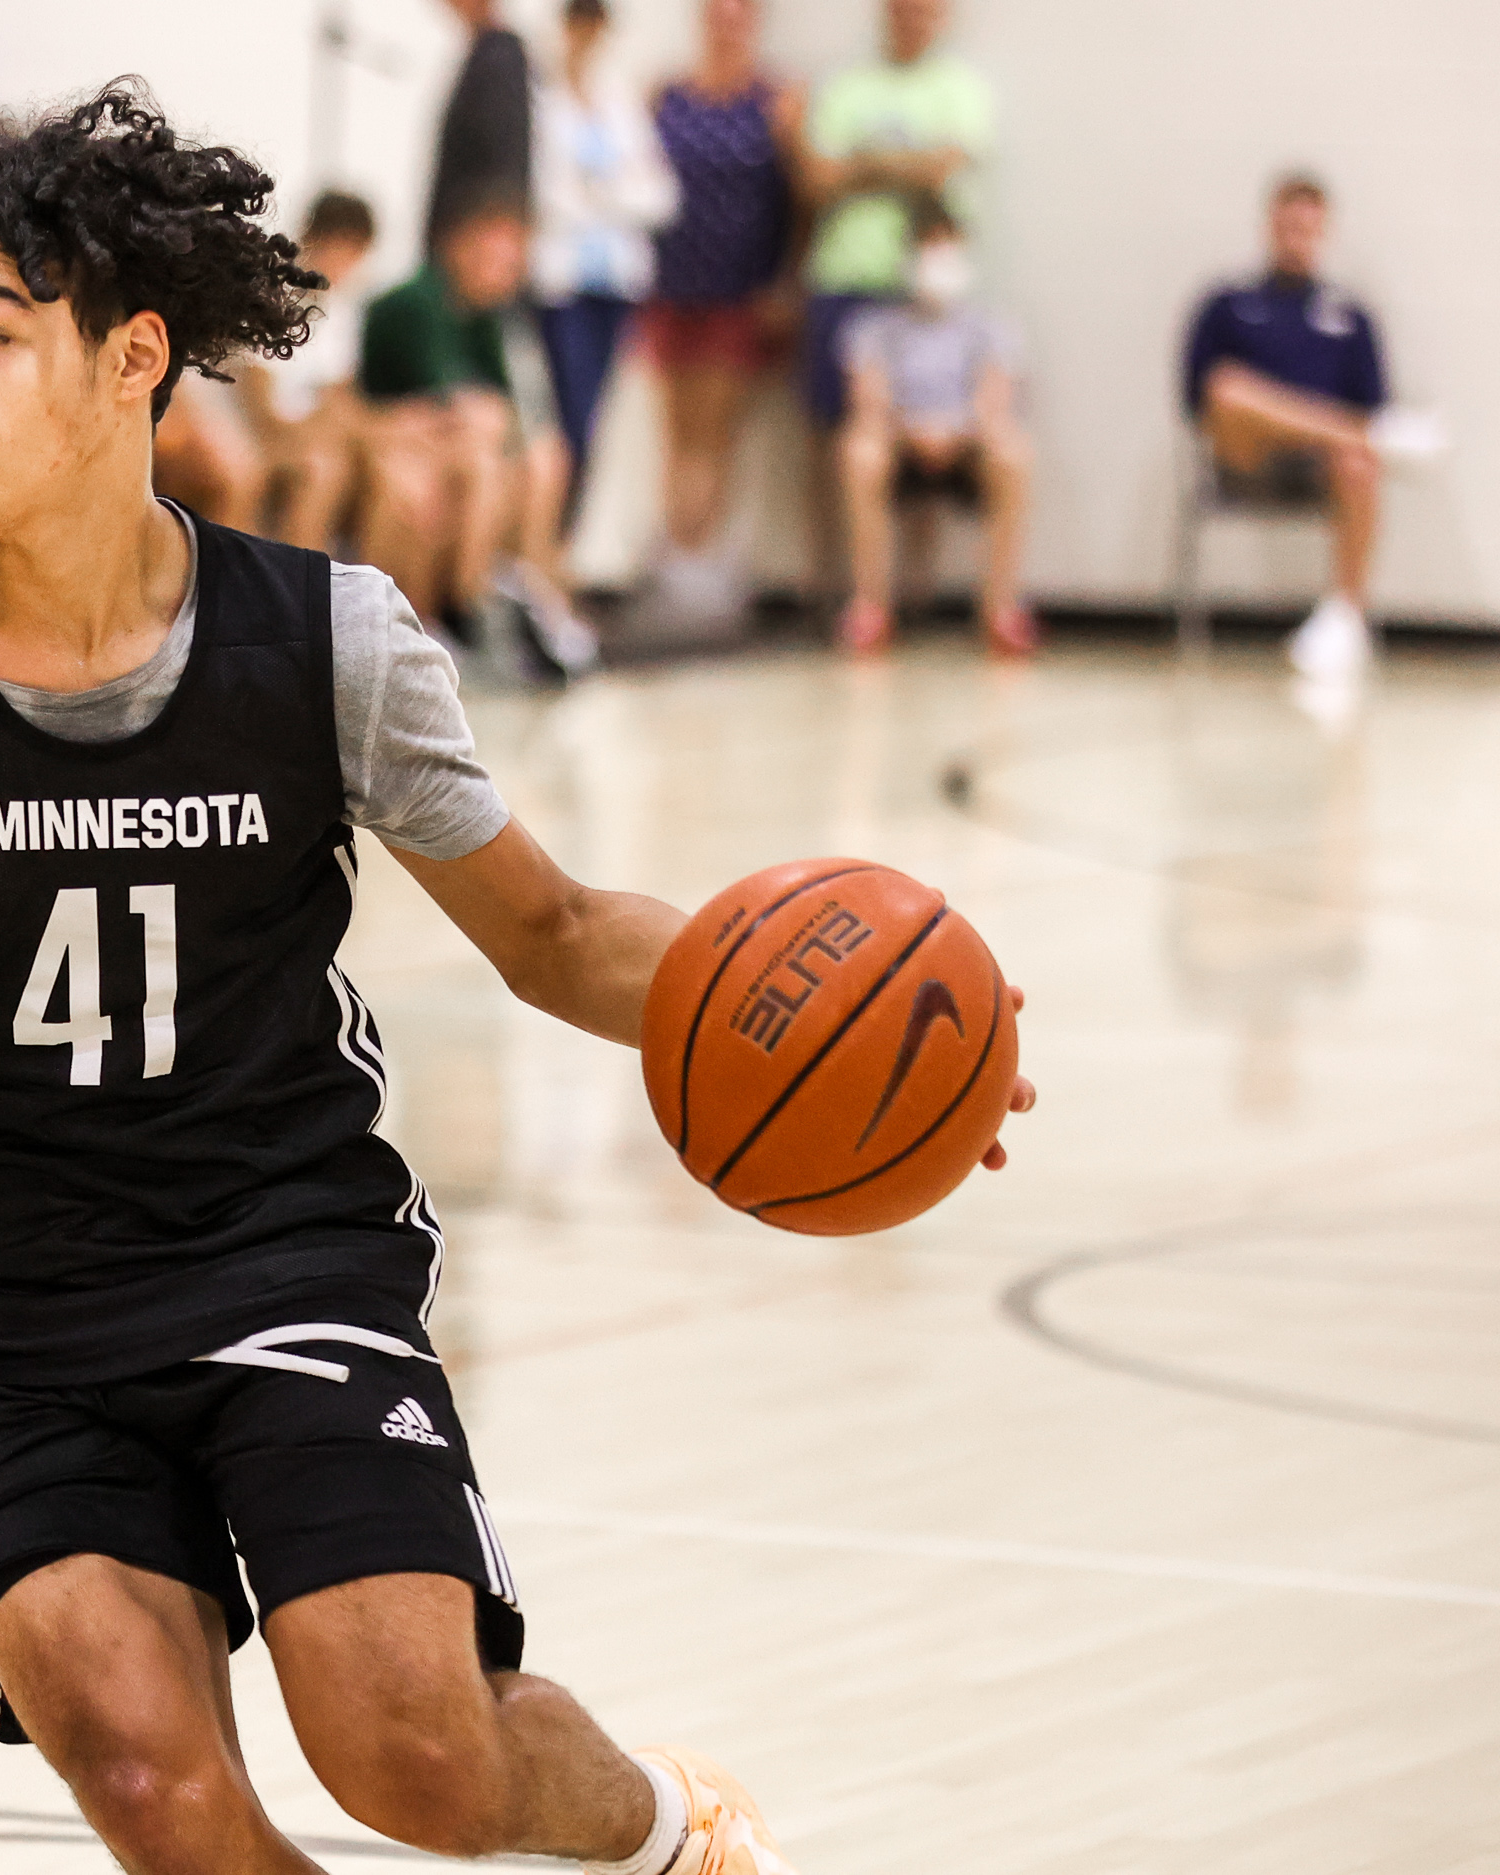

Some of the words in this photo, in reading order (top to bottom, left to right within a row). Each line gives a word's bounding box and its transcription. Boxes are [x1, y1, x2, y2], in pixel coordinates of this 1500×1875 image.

[12, 883, 178, 1087] 41
[739, 909, 873, 1053] ELITE
[380, 1422, 449, 1448] adidas
